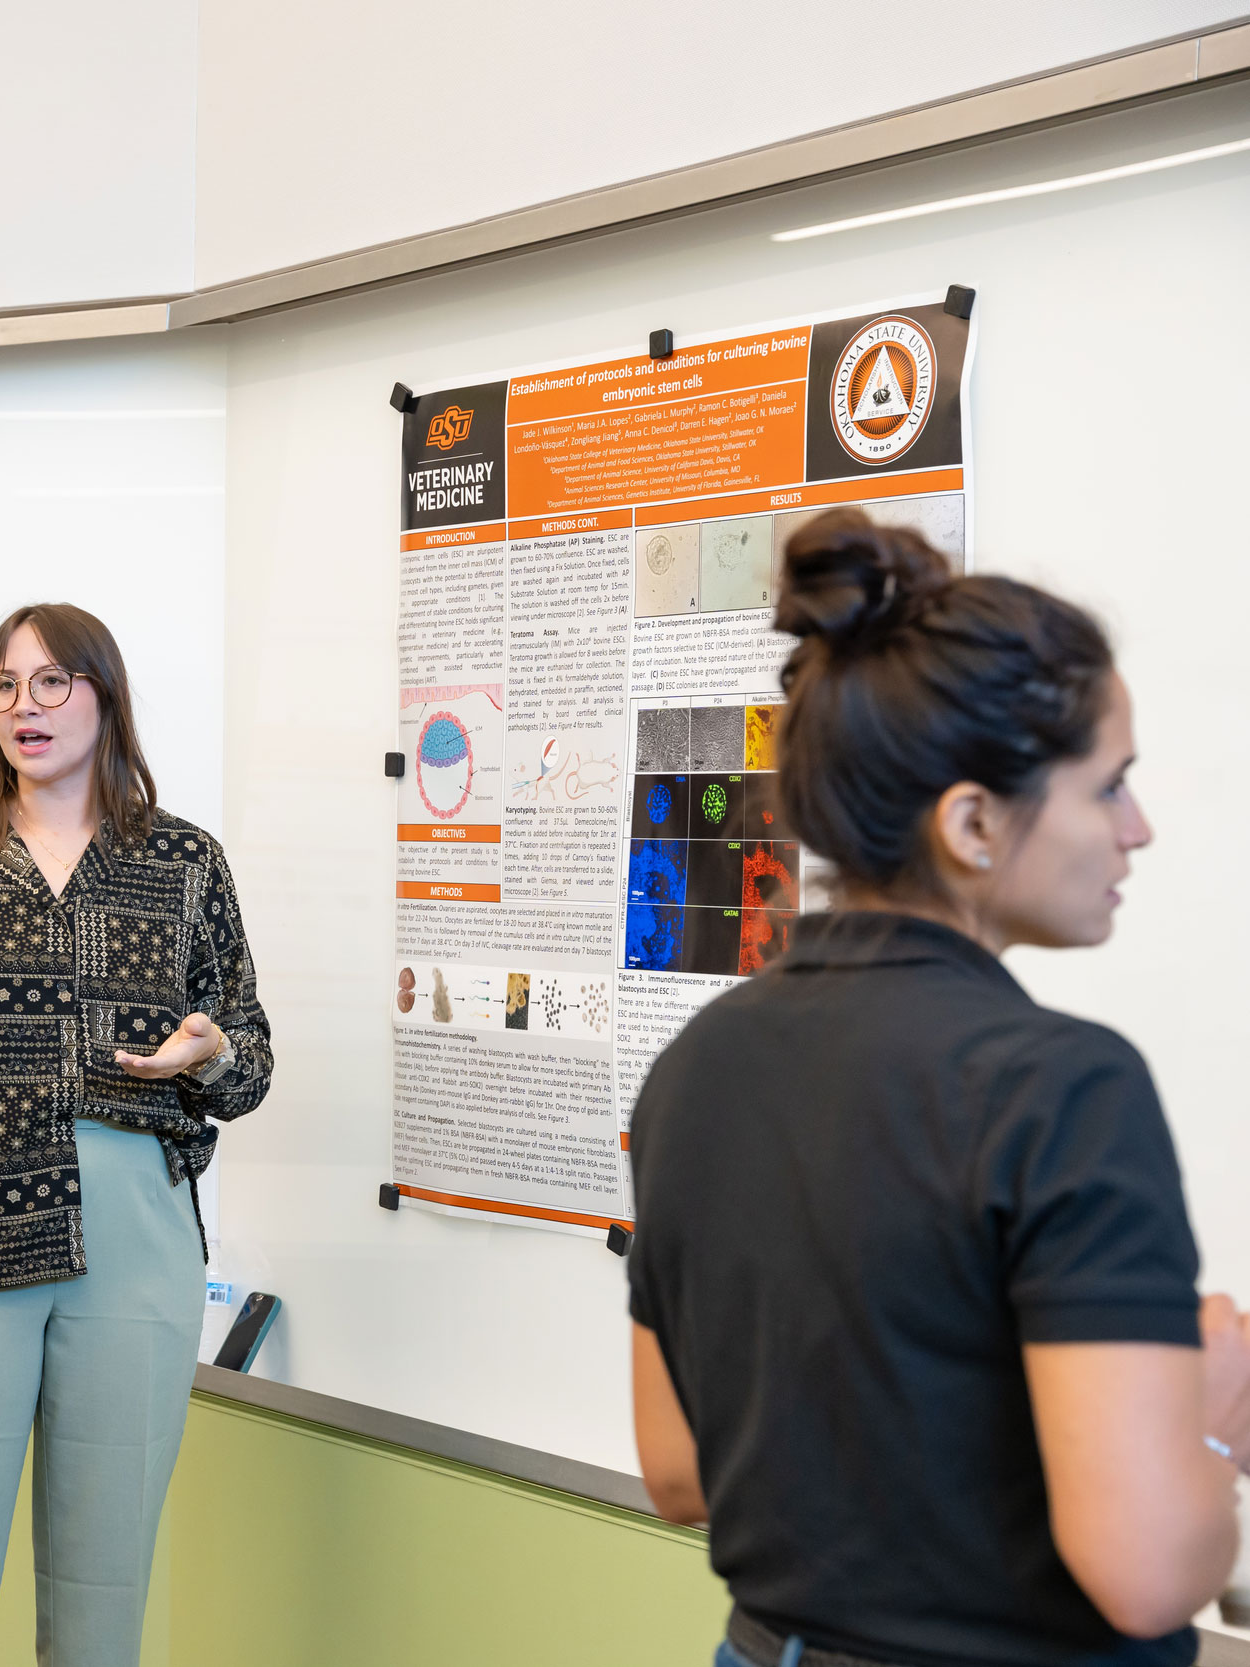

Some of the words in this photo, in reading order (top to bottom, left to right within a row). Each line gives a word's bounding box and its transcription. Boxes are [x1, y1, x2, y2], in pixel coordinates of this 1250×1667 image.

[511, 374, 574, 397] Establishment
[576, 371, 586, 386] of
[588, 364, 633, 387] protocols
[635, 360, 654, 376] and
[656, 354, 705, 373] conditions
[707, 350, 722, 364] for
[724, 342, 769, 361] culturing
[771, 335, 807, 352] bovine
[602, 382, 656, 403] embryonic
[658, 380, 681, 394] stem
[683, 374, 702, 390] cells
[838, 344, 864, 439] OKLAHOMA
[868, 325, 906, 344] STATE
[909, 335, 929, 430] UNIVERSITY
[858, 359, 881, 412] SCHOLARSHIP
[884, 358, 904, 405] INSTRUCTION
[868, 408, 894, 417] SERVICE
[426, 405, 474, 451] OSU
[869, 443, 892, 452] 1890
[410, 461, 493, 492] VETERINARY
[416, 484, 484, 512] MEDICINE
[770, 492, 802, 506] RESULTS
[542, 520, 576, 532] METHODS
[577, 518, 599, 529] CONT.
[426, 531, 476, 545] INTRODUCTION
[510, 543, 532, 552] Alkaline
[534, 540, 566, 550] Phosphatase
[568, 537, 580, 548] (AP)
[582, 536, 605, 545] Staining.
[608, 534, 618, 542] ESC
[510, 556, 527, 566] grown
[535, 552, 554, 562] 60-70%
[555, 551, 584, 560] confluence.
[586, 548, 596, 557] ESC
[607, 545, 629, 555] washed,
[690, 598, 696, 607] A
[762, 592, 767, 601] B
[634, 622, 651, 631] Figure
[658, 618, 691, 628] Development
[692, 617, 702, 625] and
[702, 615, 734, 626] propagation
[736, 614, 742, 622] of
[742, 613, 760, 622] bovine
[761, 612, 773, 620] ESC.
[510, 631, 534, 639] Teratoma
[543, 629, 559, 638] Assay.
[568, 627, 580, 635] Mice
[607, 624, 628, 634] injected
[506, 806, 538, 816] Karyotyping.
[432, 829, 466, 838] OBJECTIVES
[430, 887, 462, 897] METHODS
[618, 973, 635, 982] Figure
[648, 975, 706, 986] Immunofluorescence
[618, 984, 647, 995] blastocysts
[659, 987, 670, 996] ESC
[671, 988, 680, 997] [2].
